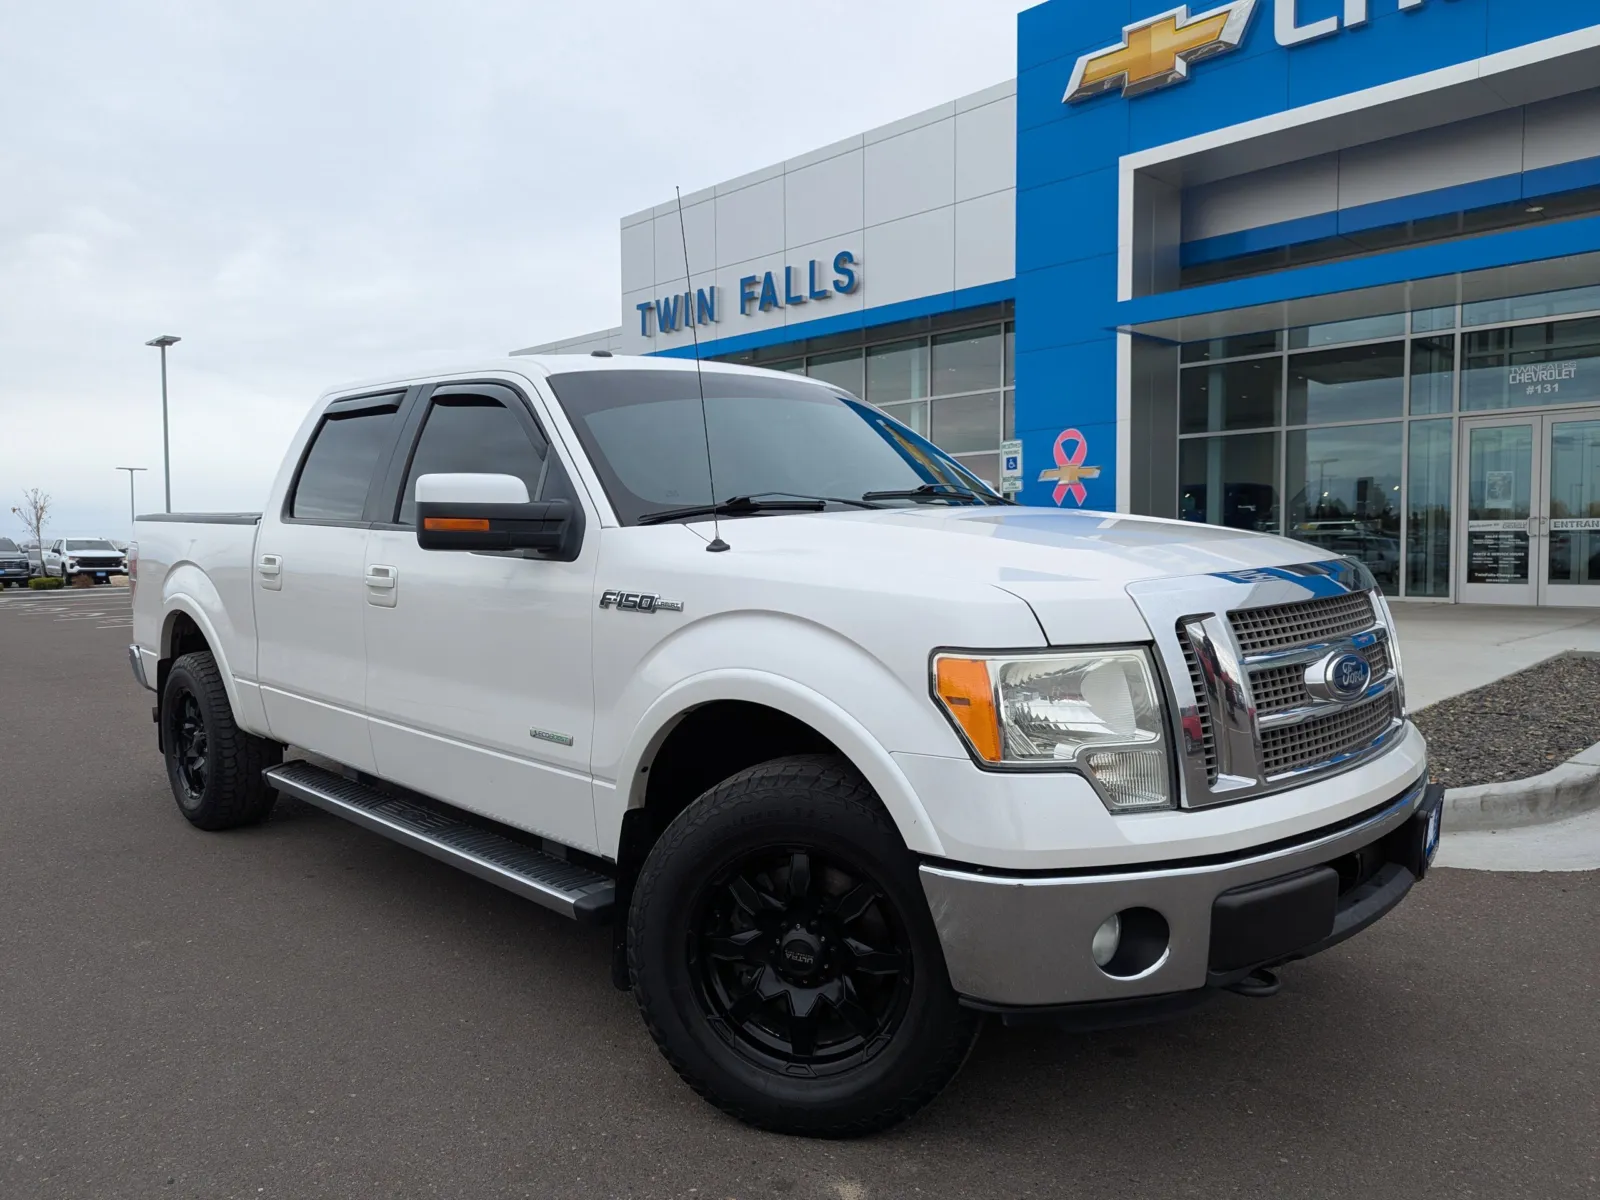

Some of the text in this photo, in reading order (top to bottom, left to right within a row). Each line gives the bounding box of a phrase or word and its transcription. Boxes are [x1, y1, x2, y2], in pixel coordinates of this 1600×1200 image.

[636, 250, 859, 337] TWIN FALLS
[1509, 367, 1577, 384] CHEVROLET
[1526, 383, 1559, 395] #131
[1342, 661, 1363, 686] Ford
[785, 953, 813, 963] ULTRA
